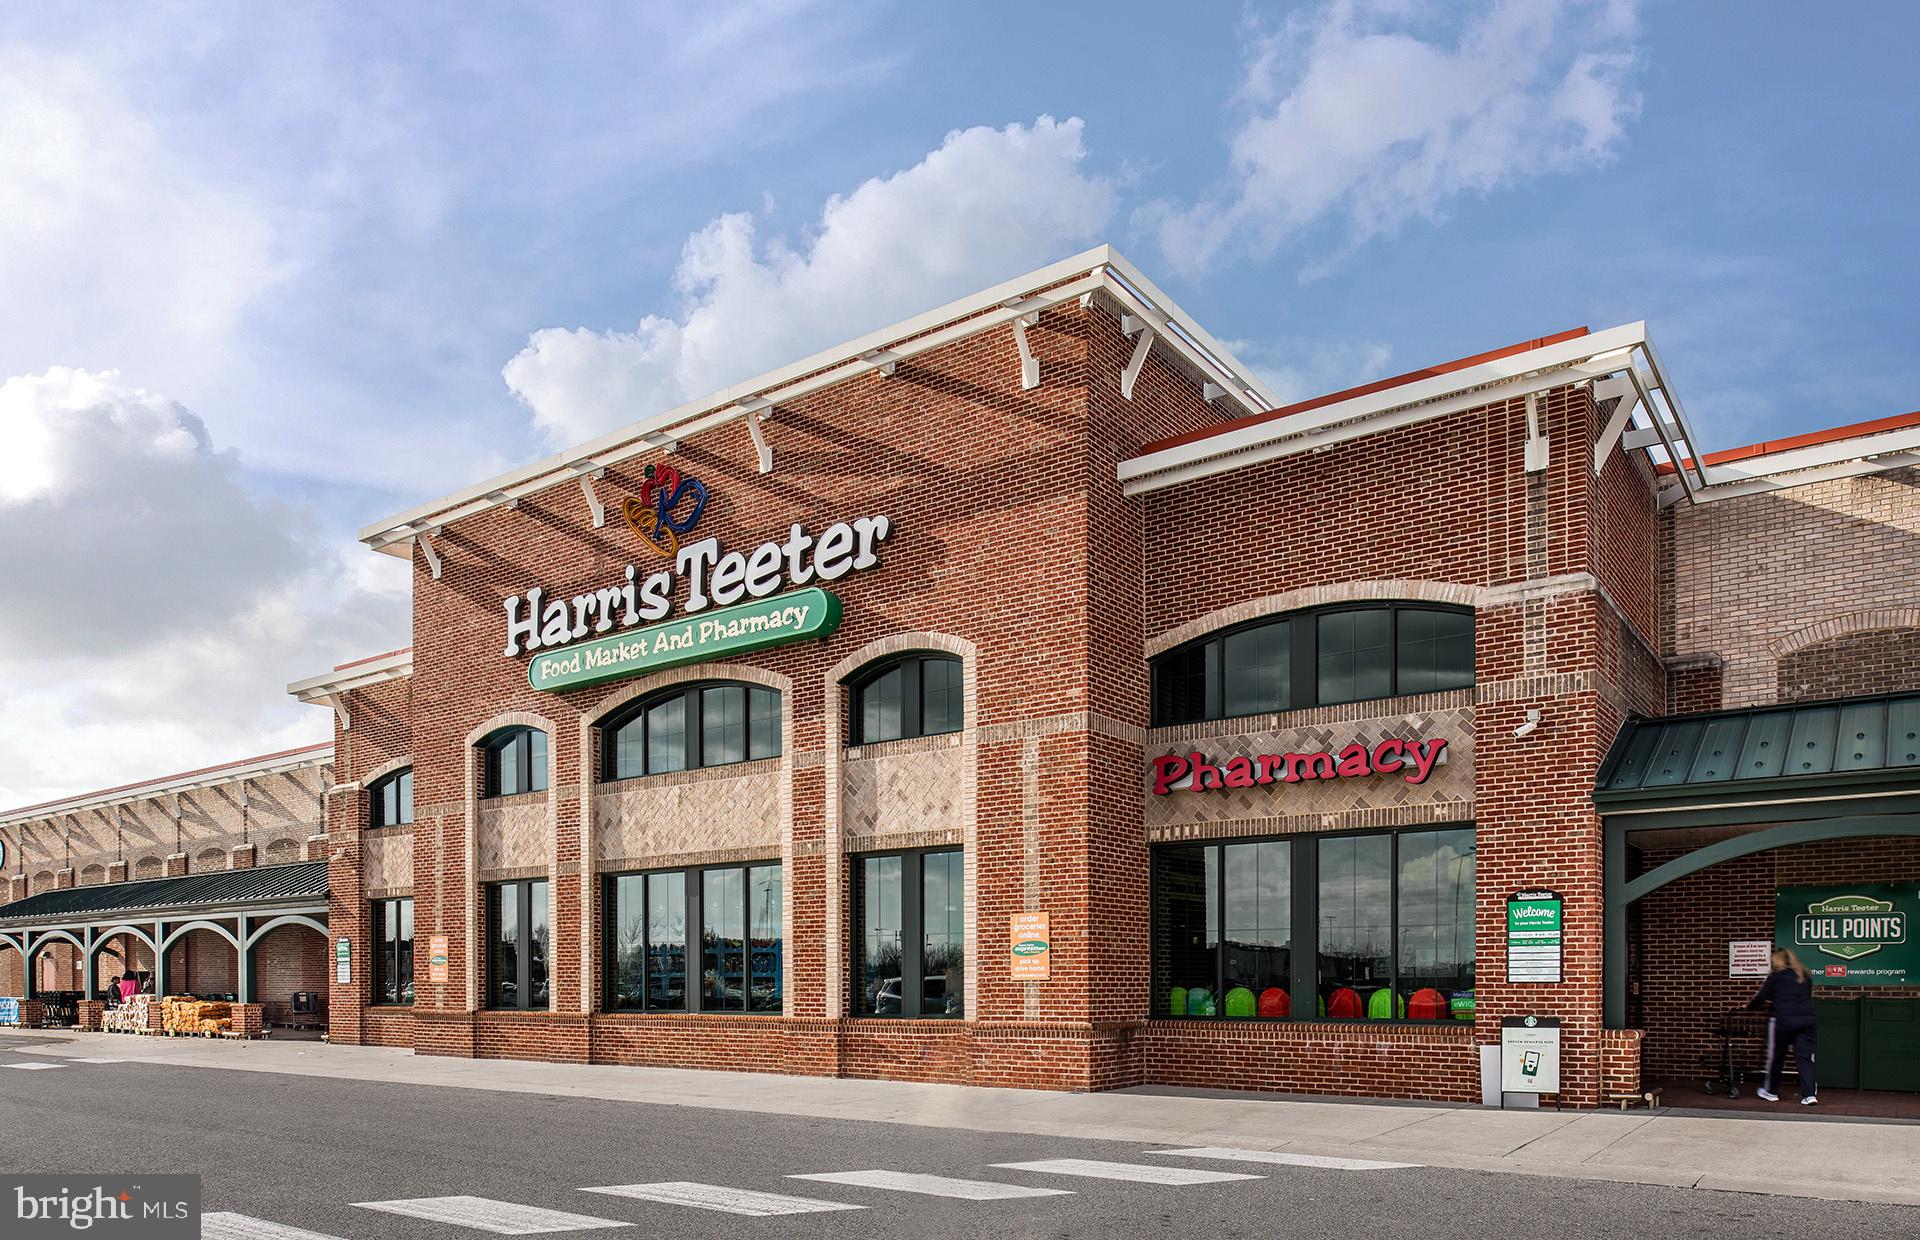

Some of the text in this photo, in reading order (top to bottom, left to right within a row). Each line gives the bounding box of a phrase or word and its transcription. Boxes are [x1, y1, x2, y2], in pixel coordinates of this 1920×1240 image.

[503, 514, 891, 658] Harris Teeter
[540, 603, 810, 681] Food Market And Pharmacy
[1151, 738, 1449, 796] Pharmacy
[1512, 905, 1556, 919] Welcome
[1821, 904, 1880, 913] Harris Teeter
[1801, 917, 1901, 940] FUEL POINTS
[1876, 968, 1906, 976] program
[1453, 1000, 1473, 1008] eWIC
